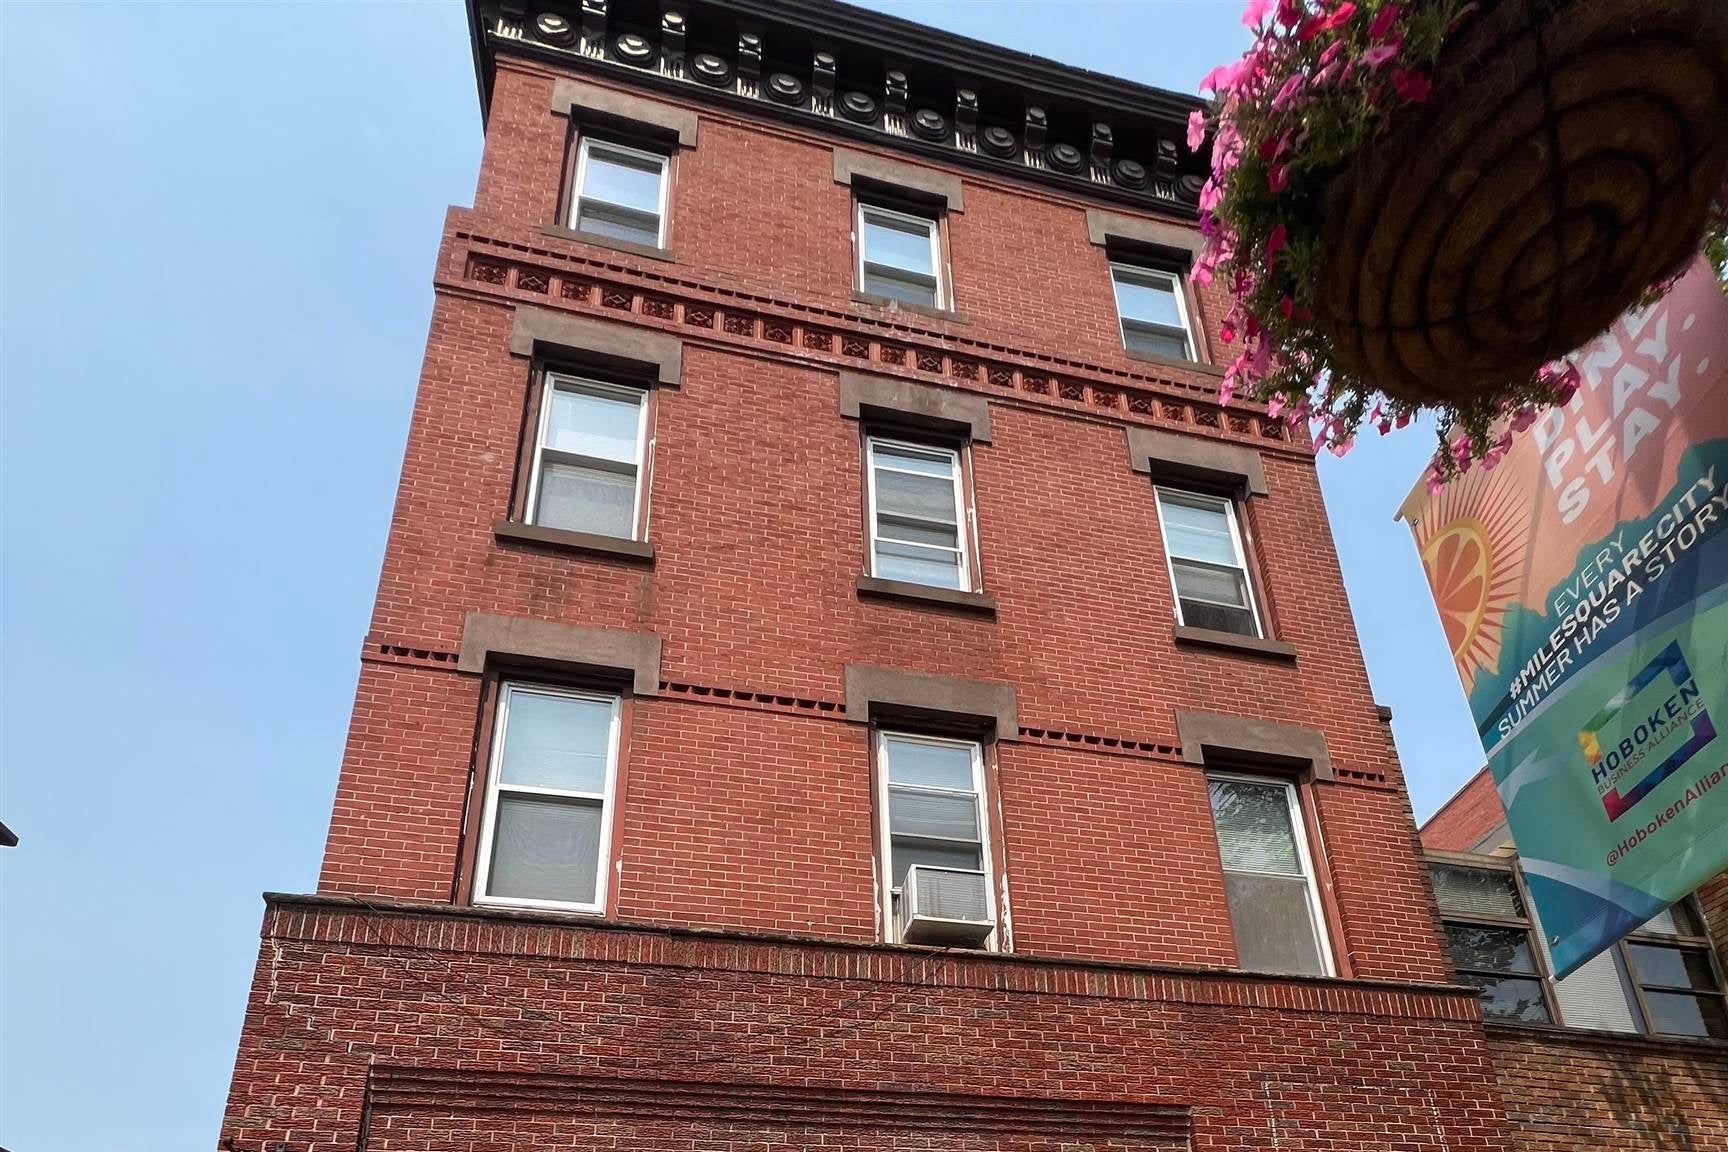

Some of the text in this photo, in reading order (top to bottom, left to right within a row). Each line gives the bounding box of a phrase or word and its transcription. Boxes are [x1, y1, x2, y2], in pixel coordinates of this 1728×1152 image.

[1545, 310, 1696, 490] PLAY.
[1557, 353, 1710, 525] STAY.
[1498, 483, 1728, 738] SUMMER HAS A STORY
[1510, 464, 1715, 699] #MILESQUARECITY
[1553, 530, 1624, 618] EVERY
[1591, 679, 1700, 784] HOBOKEN
[1598, 698, 1705, 795] BUSINESS ALLIANCE
